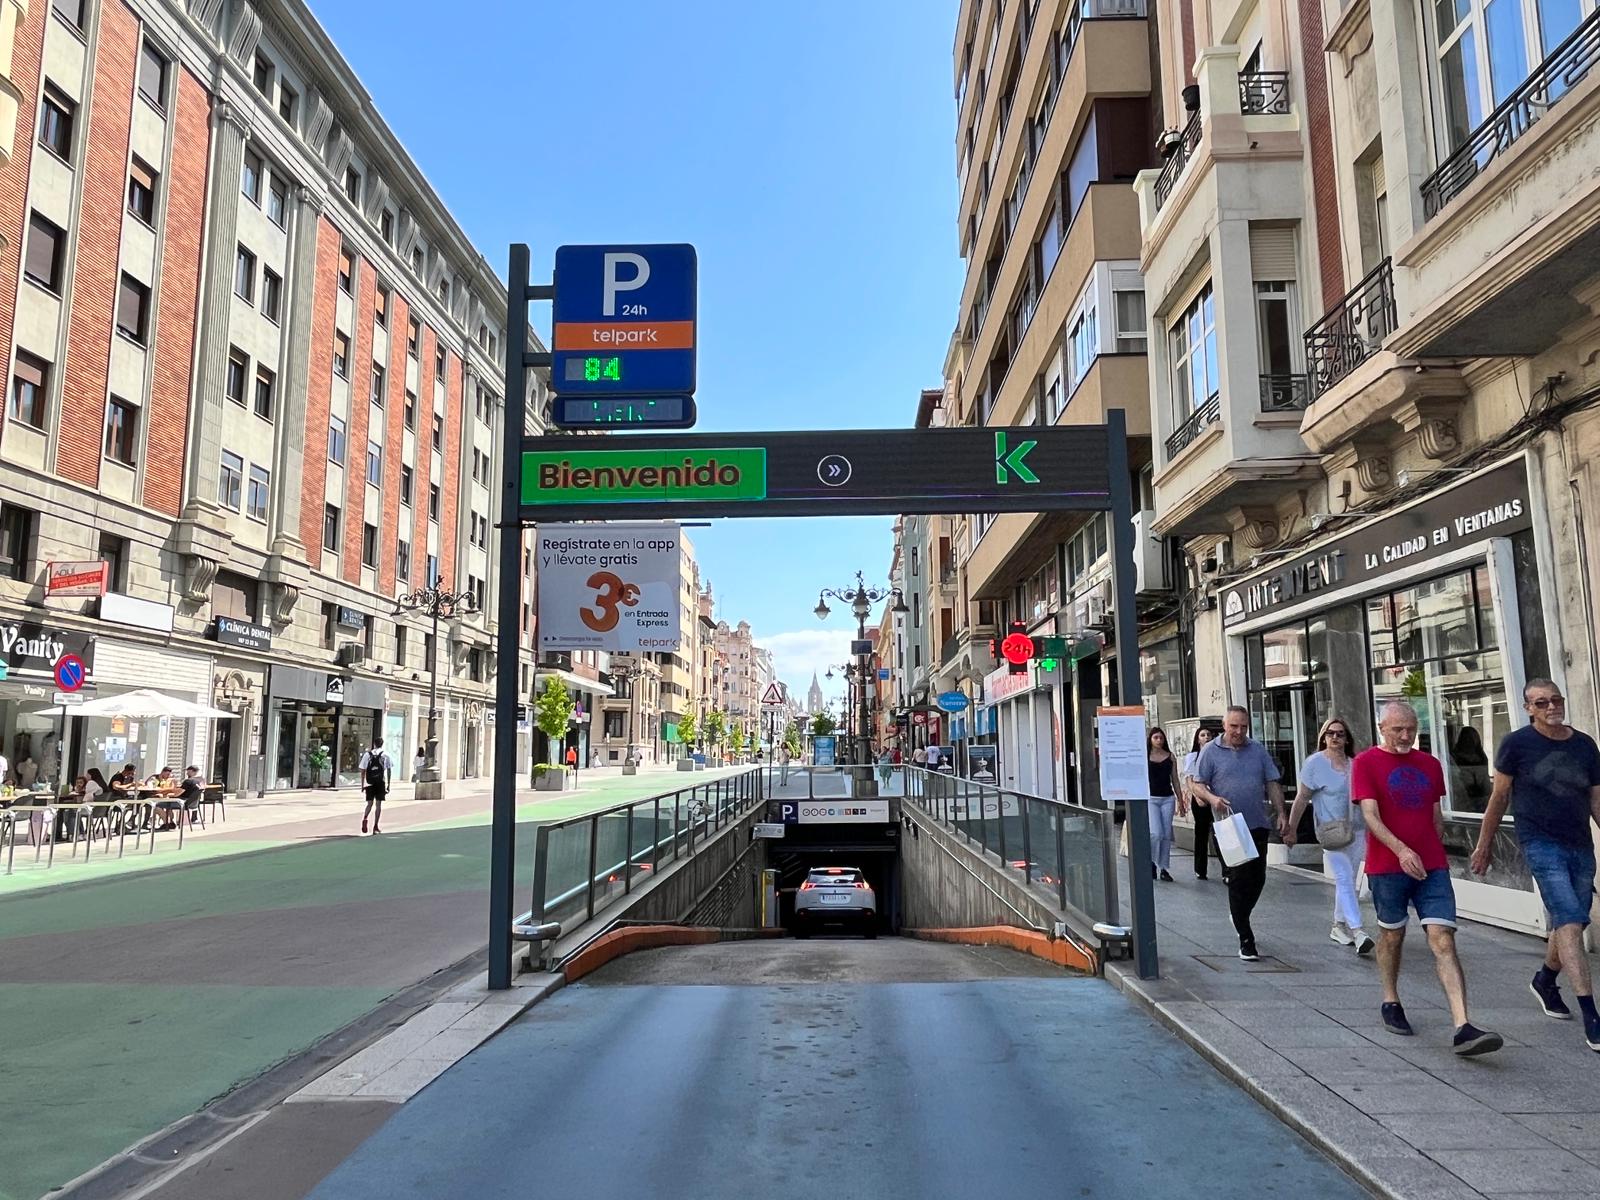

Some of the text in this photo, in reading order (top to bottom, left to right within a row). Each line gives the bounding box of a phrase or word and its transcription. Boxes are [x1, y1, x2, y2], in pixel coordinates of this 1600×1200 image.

[603, 252, 650, 316] P
[622, 304, 648, 316] 24h
[592, 328, 658, 345] telpark
[584, 357, 620, 381] 84
[538, 459, 740, 489] Bienvenido
[1365, 499, 1523, 570] LA CALIDAD EN VENTANAS
[543, 538, 675, 553] Regístrate en la app
[543, 553, 638, 568] y llévate gratis
[636, 610, 669, 618] Entrada
[636, 619, 669, 628] Express
[0, 625, 64, 667] Vanity
[638, 637, 677, 647] telpark
[782, 804, 793, 820] P
